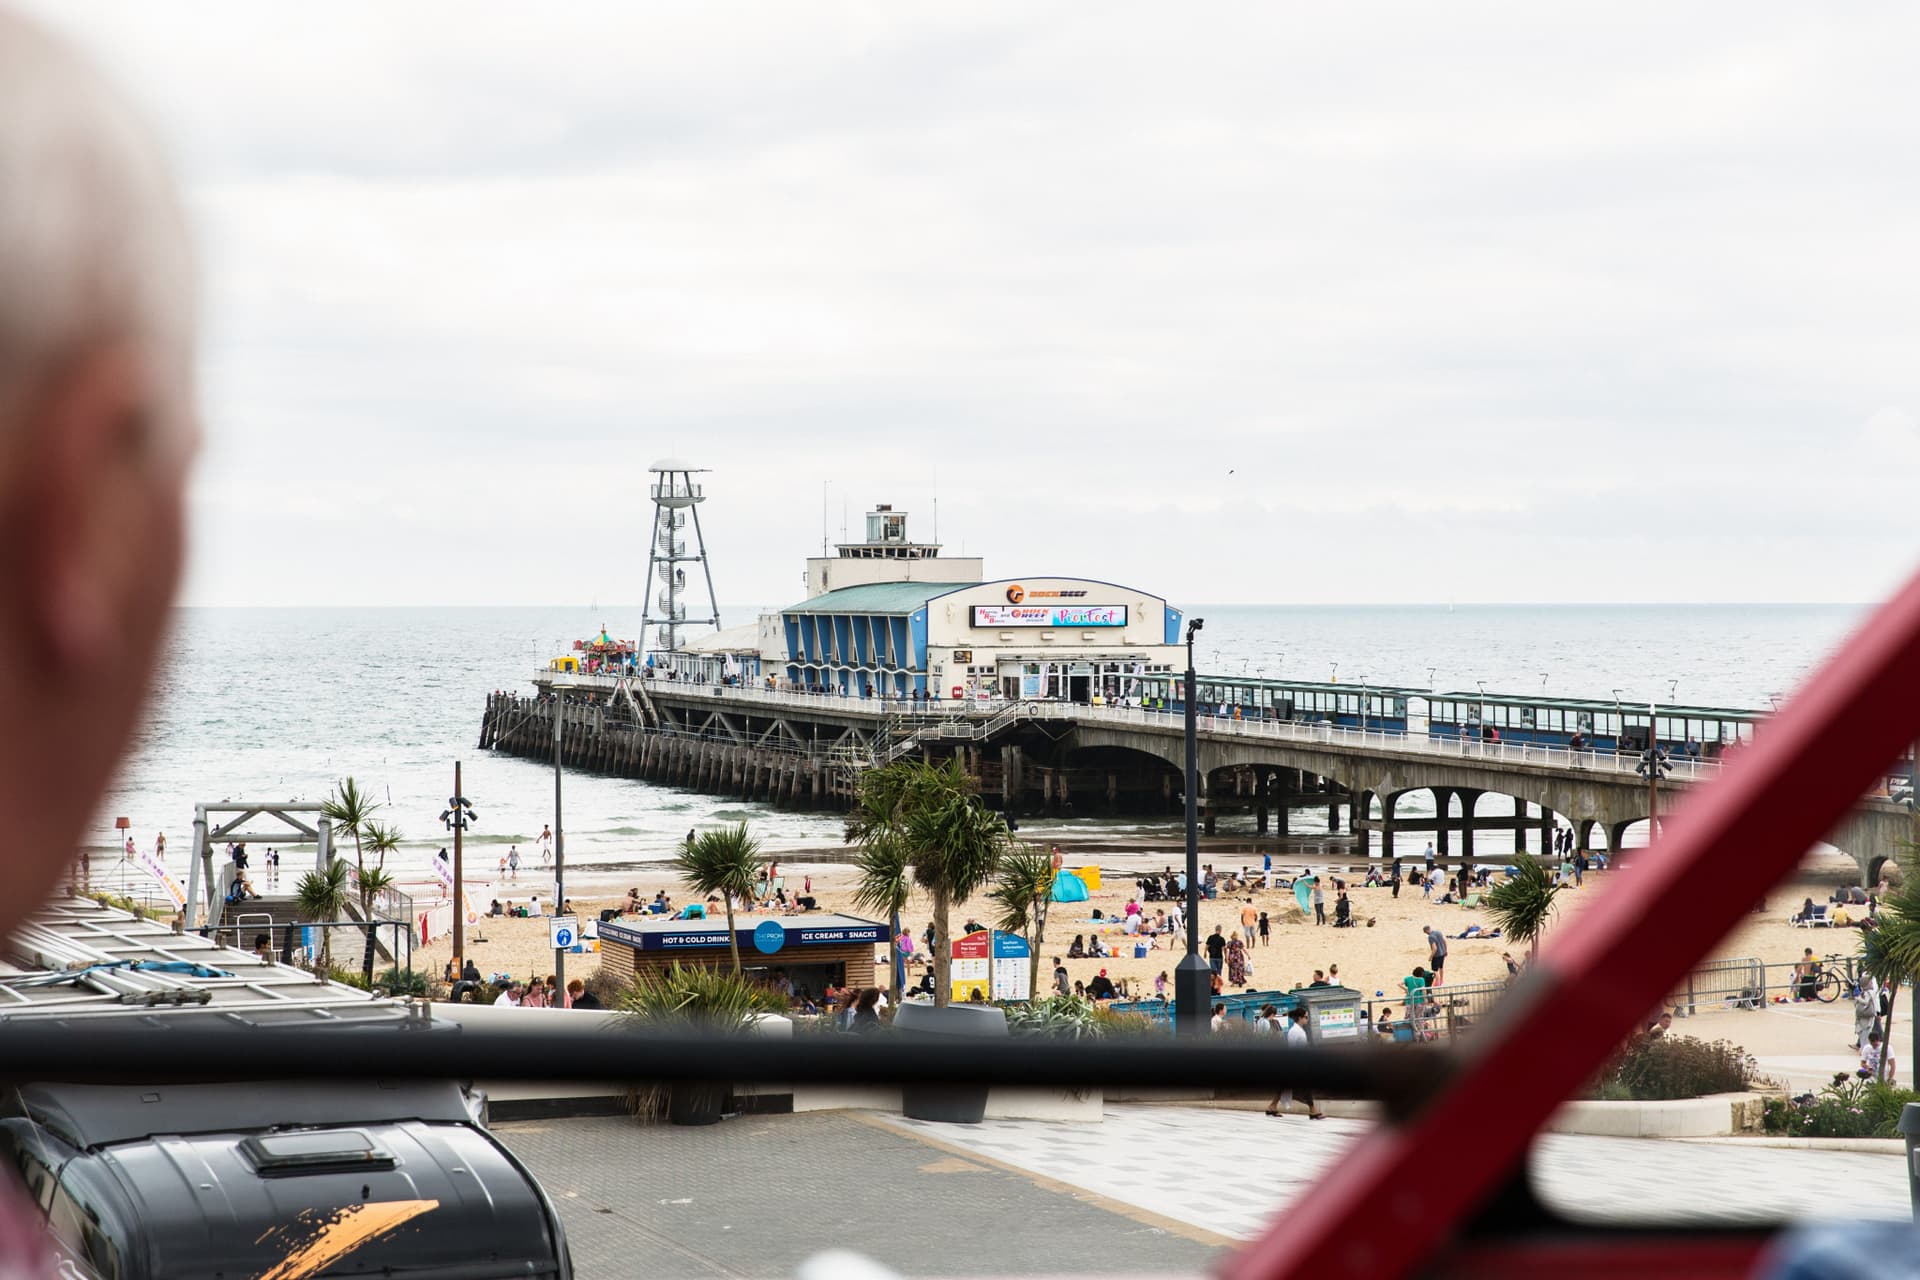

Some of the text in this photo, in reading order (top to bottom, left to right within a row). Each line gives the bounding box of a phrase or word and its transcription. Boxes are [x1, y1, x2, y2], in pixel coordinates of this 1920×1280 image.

[662, 937, 678, 945] HOT
[685, 936, 706, 944] COLD
[707, 935, 731, 944] DRINK
[801, 931, 877, 940] ICE CREAMS SNACKS
